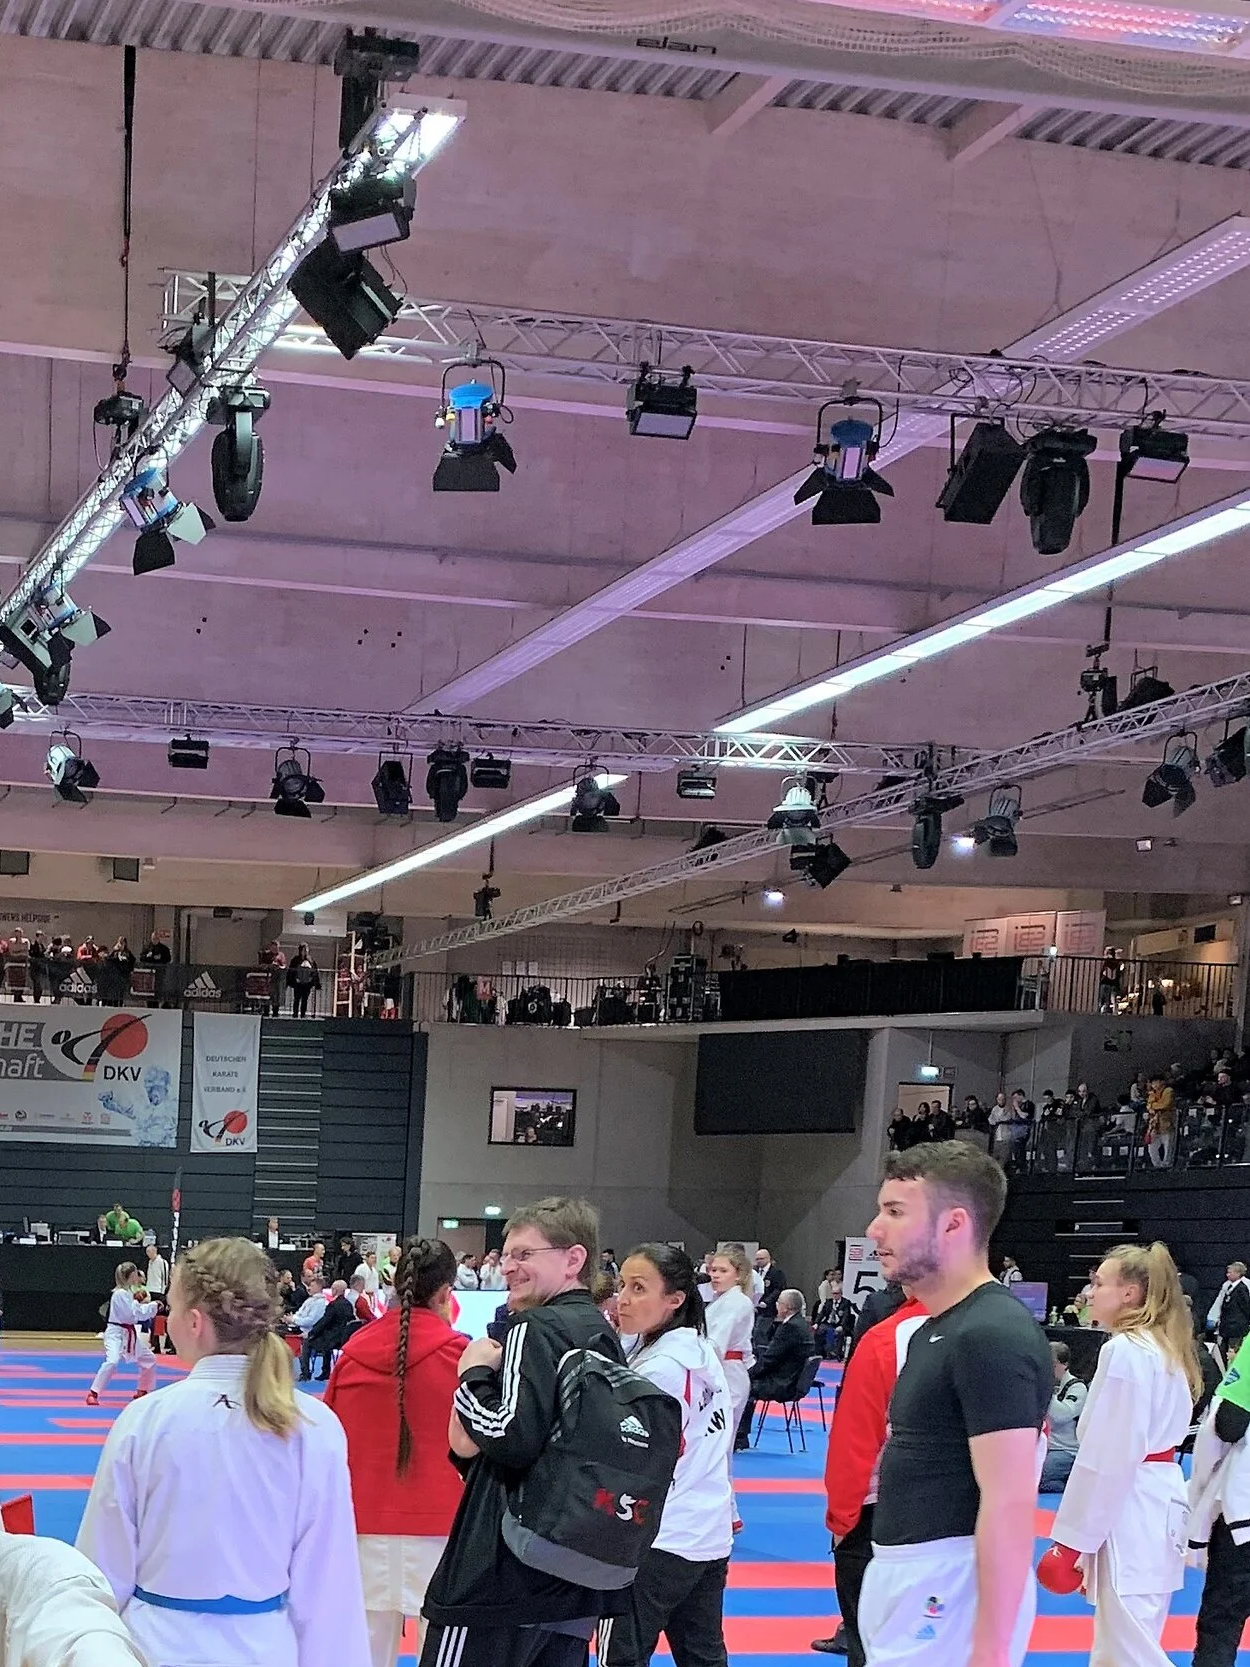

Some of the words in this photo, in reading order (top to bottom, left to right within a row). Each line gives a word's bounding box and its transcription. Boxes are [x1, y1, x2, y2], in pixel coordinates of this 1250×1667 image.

[58, 982, 98, 995] adidas
[183, 987, 223, 999] adidas
[206, 1055, 248, 1064] DEUTSCHER
[103, 1065, 142, 1082] DKV
[212, 1070, 239, 1078] KARATE
[203, 1086, 236, 1094] VERBAND
[225, 1137, 247, 1147] DKV
